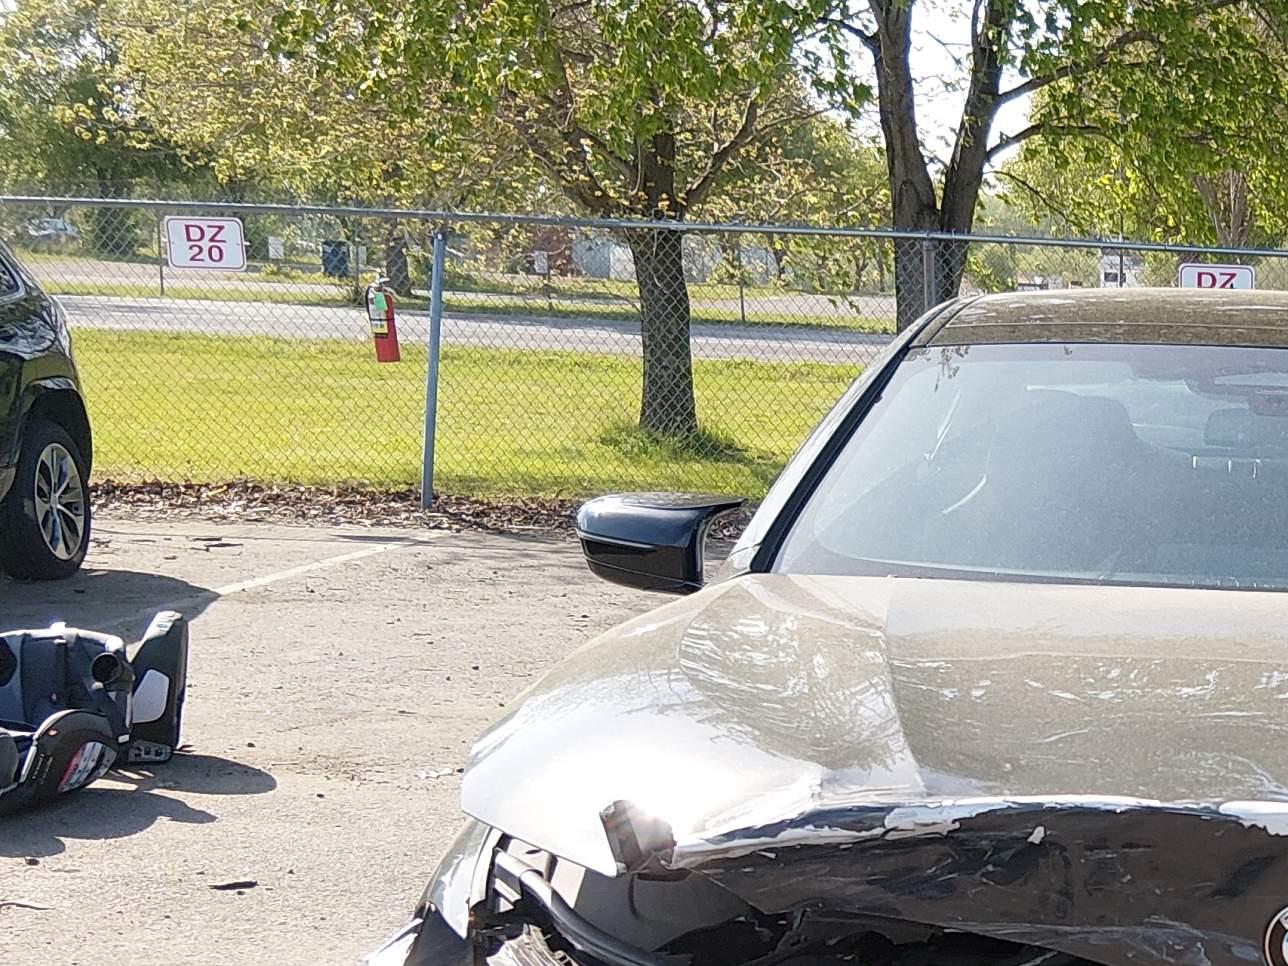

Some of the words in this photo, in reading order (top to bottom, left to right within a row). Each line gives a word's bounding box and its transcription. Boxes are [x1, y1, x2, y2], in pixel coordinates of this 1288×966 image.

[184, 224, 227, 243] DZ
[188, 244, 224, 262] 20
[1196, 271, 1238, 289] DZ
